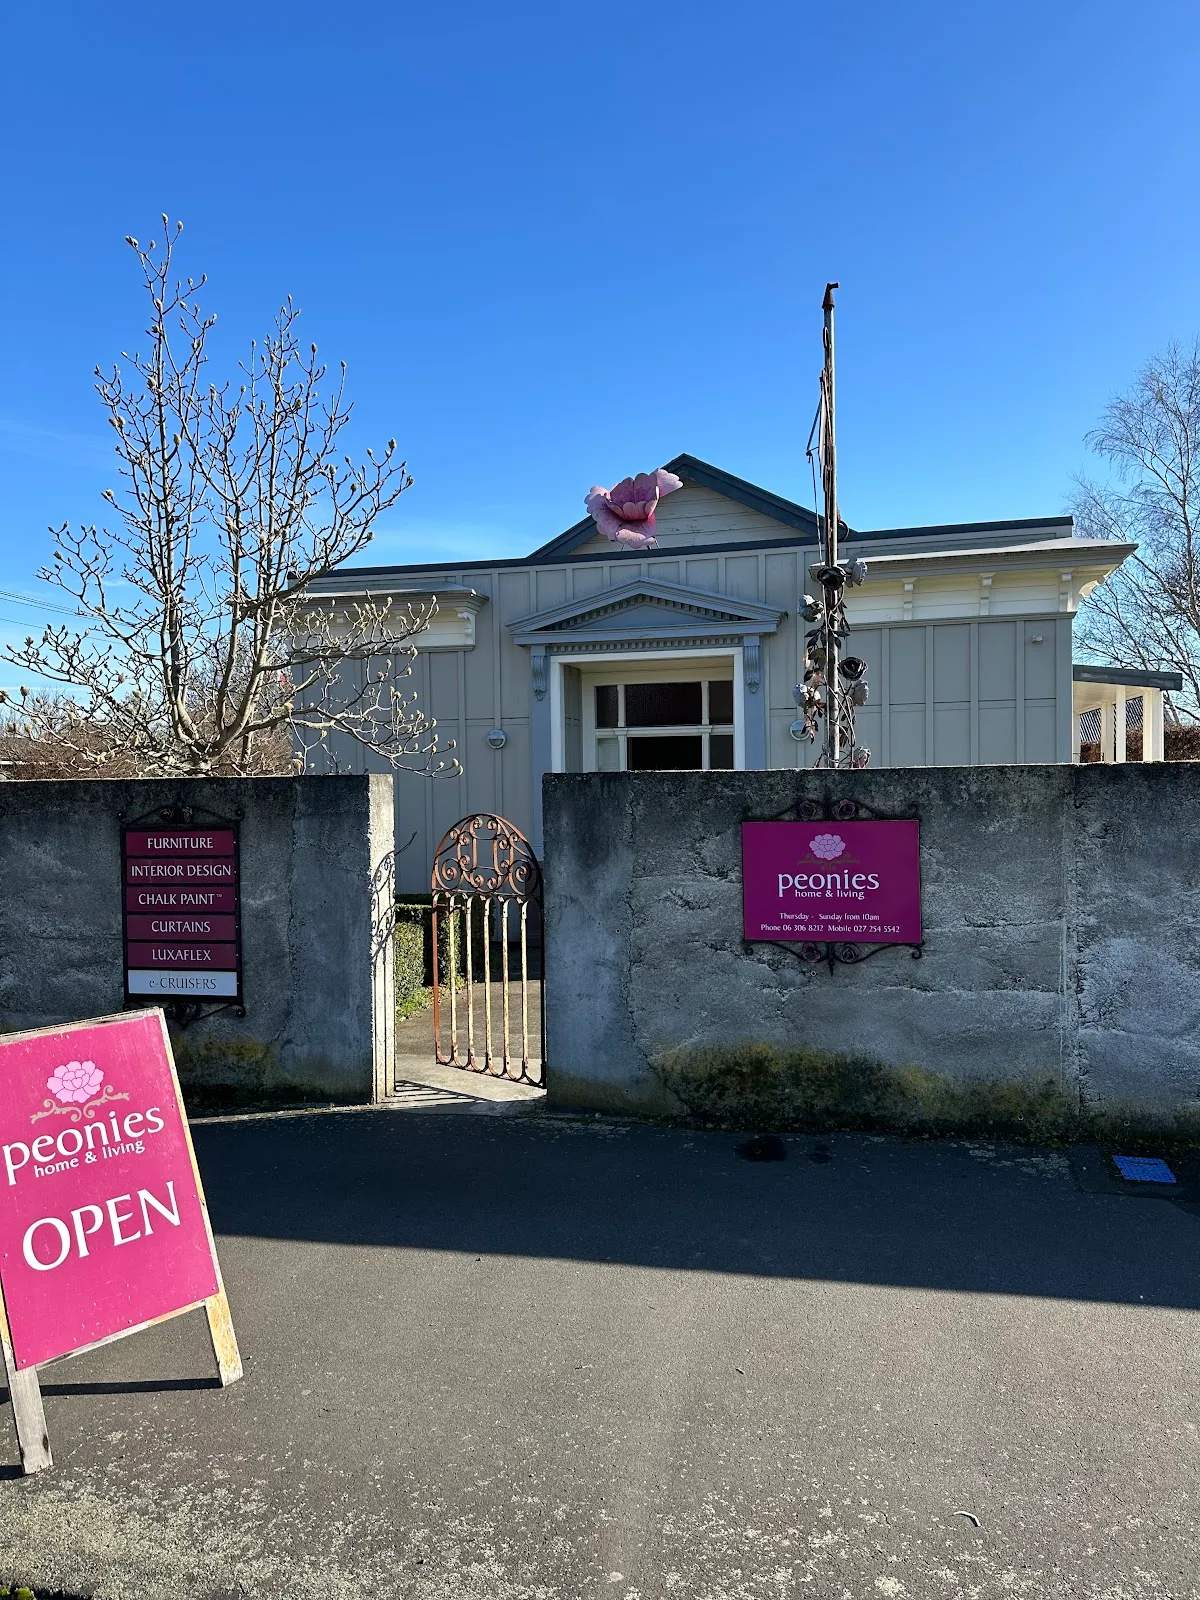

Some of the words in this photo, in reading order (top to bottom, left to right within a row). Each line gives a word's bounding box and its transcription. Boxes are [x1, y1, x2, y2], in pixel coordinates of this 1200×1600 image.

[147, 837, 214, 849] FURNITURE
[131, 865, 184, 877] INTERIOR
[187, 864, 232, 876] DESIGN
[778, 869, 880, 898] peonies
[138, 893, 179, 905] CHALK
[795, 889, 822, 898] home
[825, 889, 834, 898] &
[837, 889, 865, 900] living
[779, 912, 810, 921] Thursday
[818, 913, 843, 921] Sunday
[844, 913, 861, 921] from
[862, 913, 880, 921] 10am
[151, 921, 211, 933] CURTAINS
[760, 924, 781, 932] Phone
[868, 925, 882, 933] 254
[883, 925, 900, 933] 5542
[152, 949, 212, 961] LUXAFLEX
[2, 1107, 165, 1186] peonies
[33, 1156, 79, 1178] home
[84, 1151, 97, 1164] &
[101, 1140, 145, 1159] living
[22, 1180, 181, 1271] OPEN
